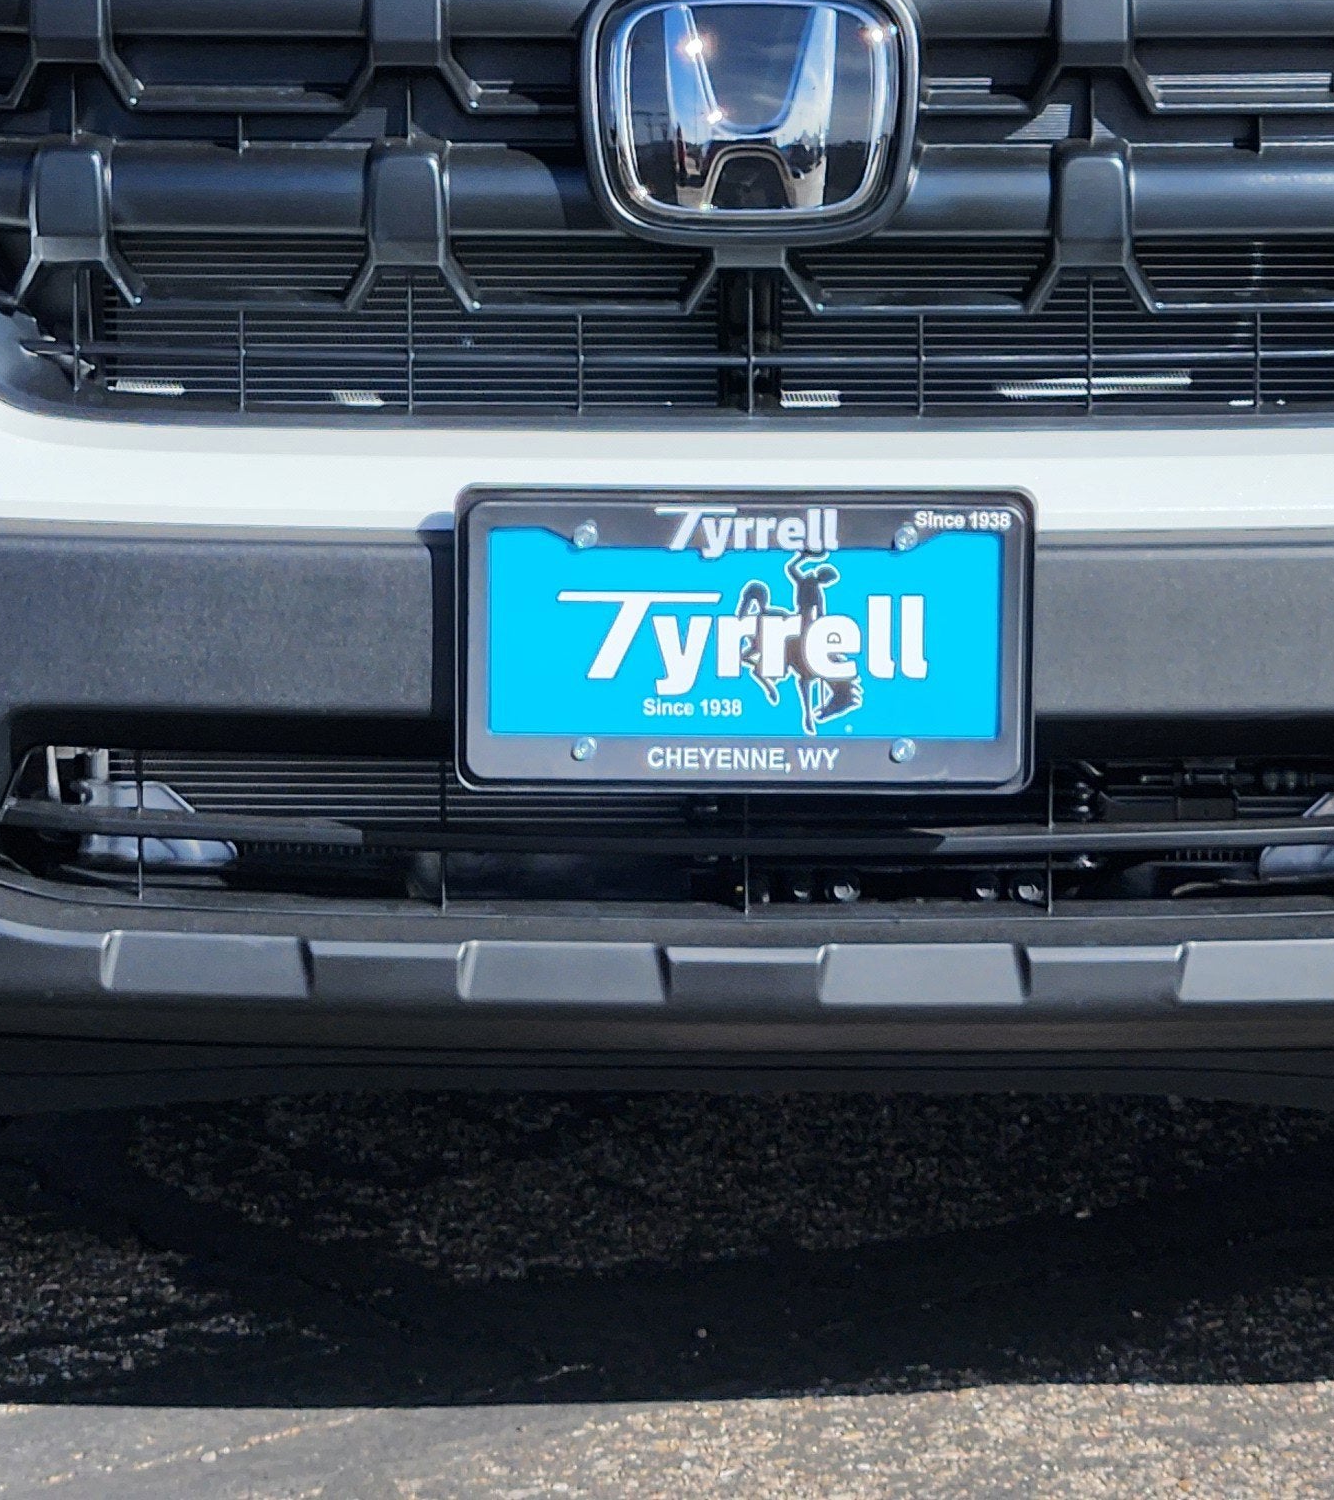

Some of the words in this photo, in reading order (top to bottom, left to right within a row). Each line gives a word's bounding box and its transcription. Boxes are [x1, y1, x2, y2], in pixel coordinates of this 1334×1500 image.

[653, 506, 839, 559] Tyrrell
[914, 510, 966, 529] Since
[968, 510, 1012, 531] 1938
[557, 590, 929, 696] Tyrrell
[642, 697, 695, 717] Since
[699, 698, 743, 717] 1938
[647, 746, 792, 774] CHEYENNE,
[798, 747, 840, 771] WY
